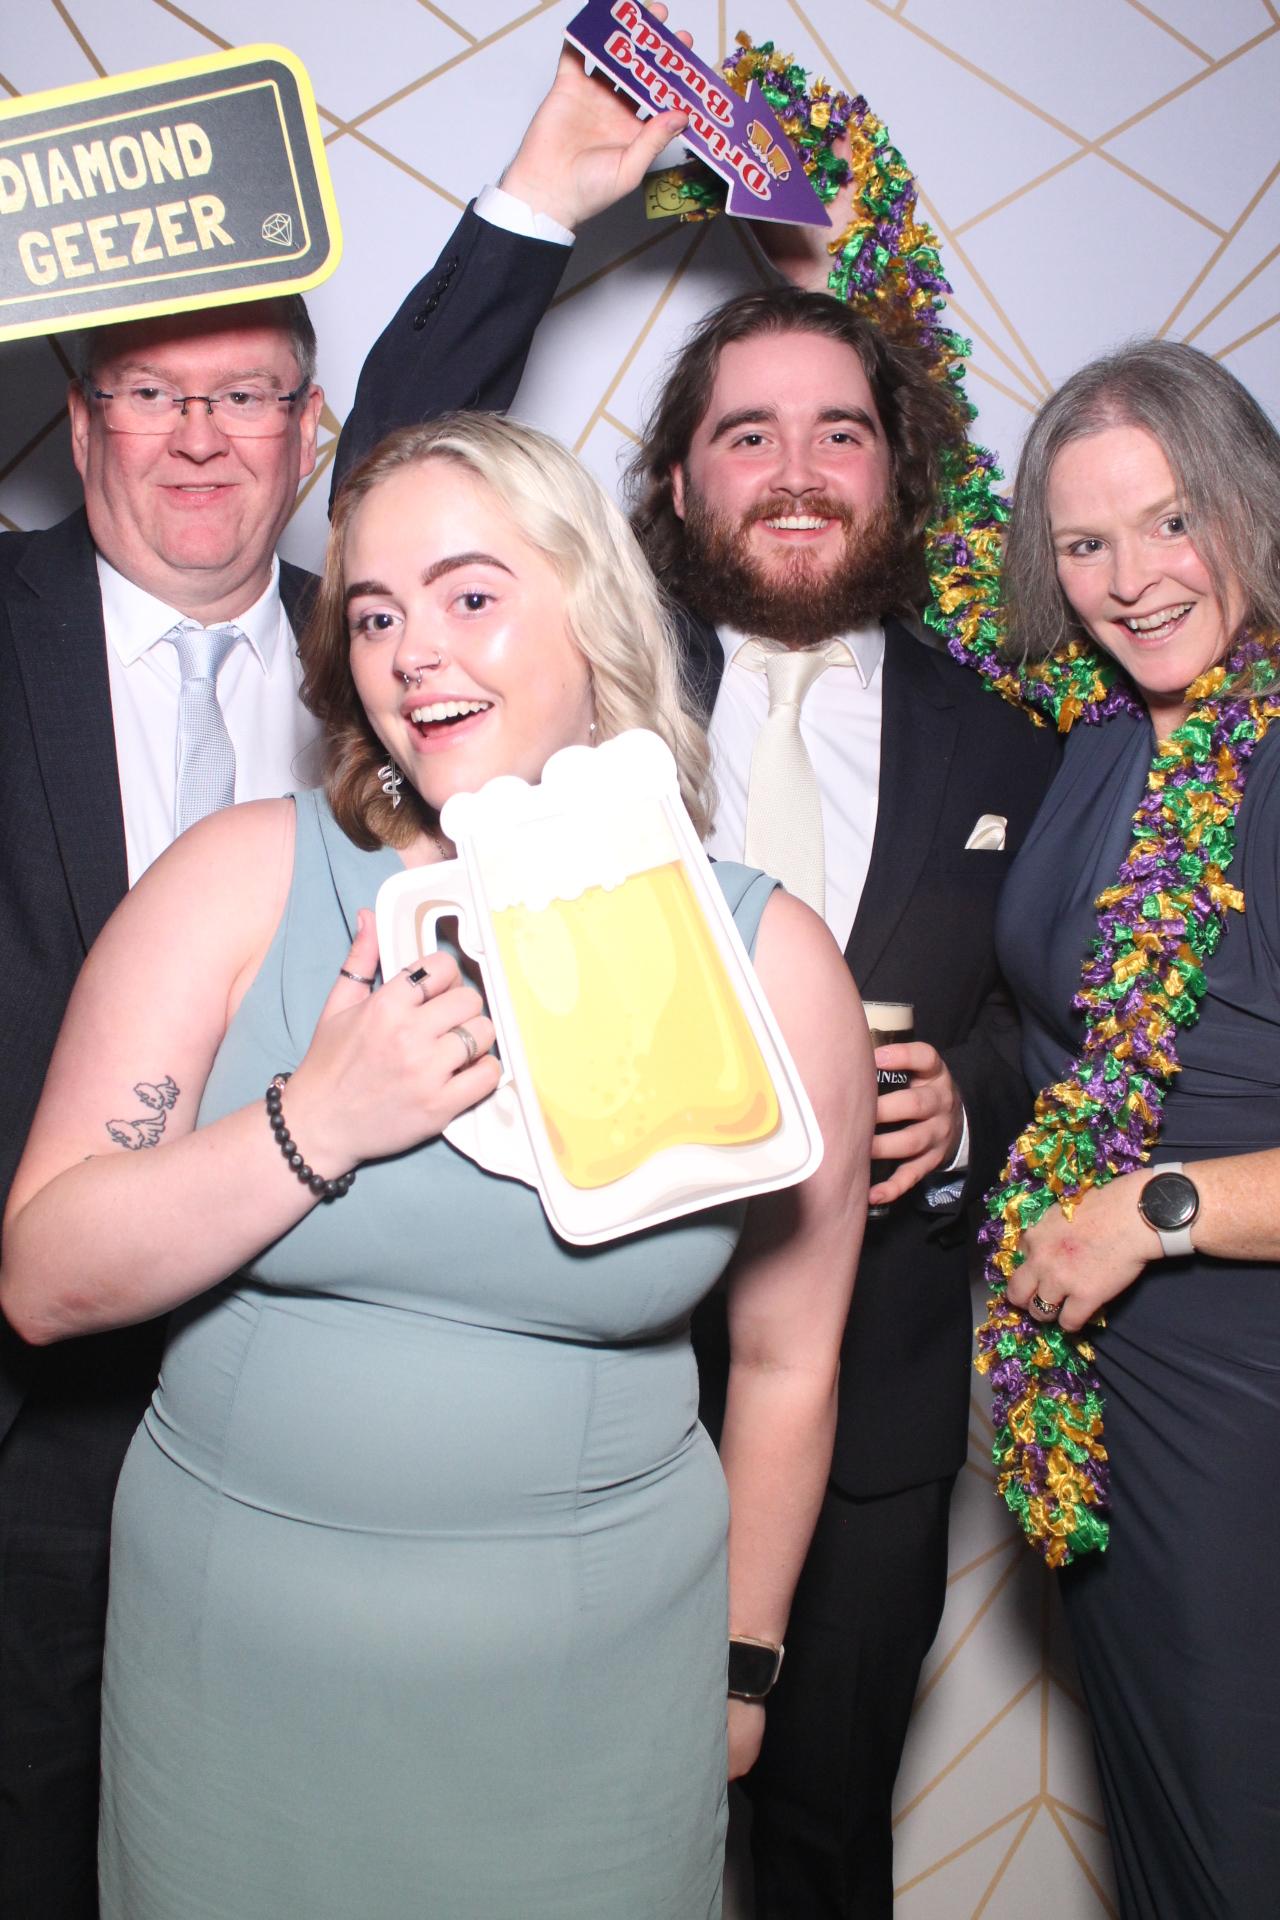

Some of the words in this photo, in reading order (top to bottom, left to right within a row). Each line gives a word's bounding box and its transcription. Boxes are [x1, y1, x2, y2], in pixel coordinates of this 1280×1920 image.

[613, 2, 733, 124] Buddy
[0, 122, 213, 215] DIAMOND
[17, 194, 235, 286] GEEZER
